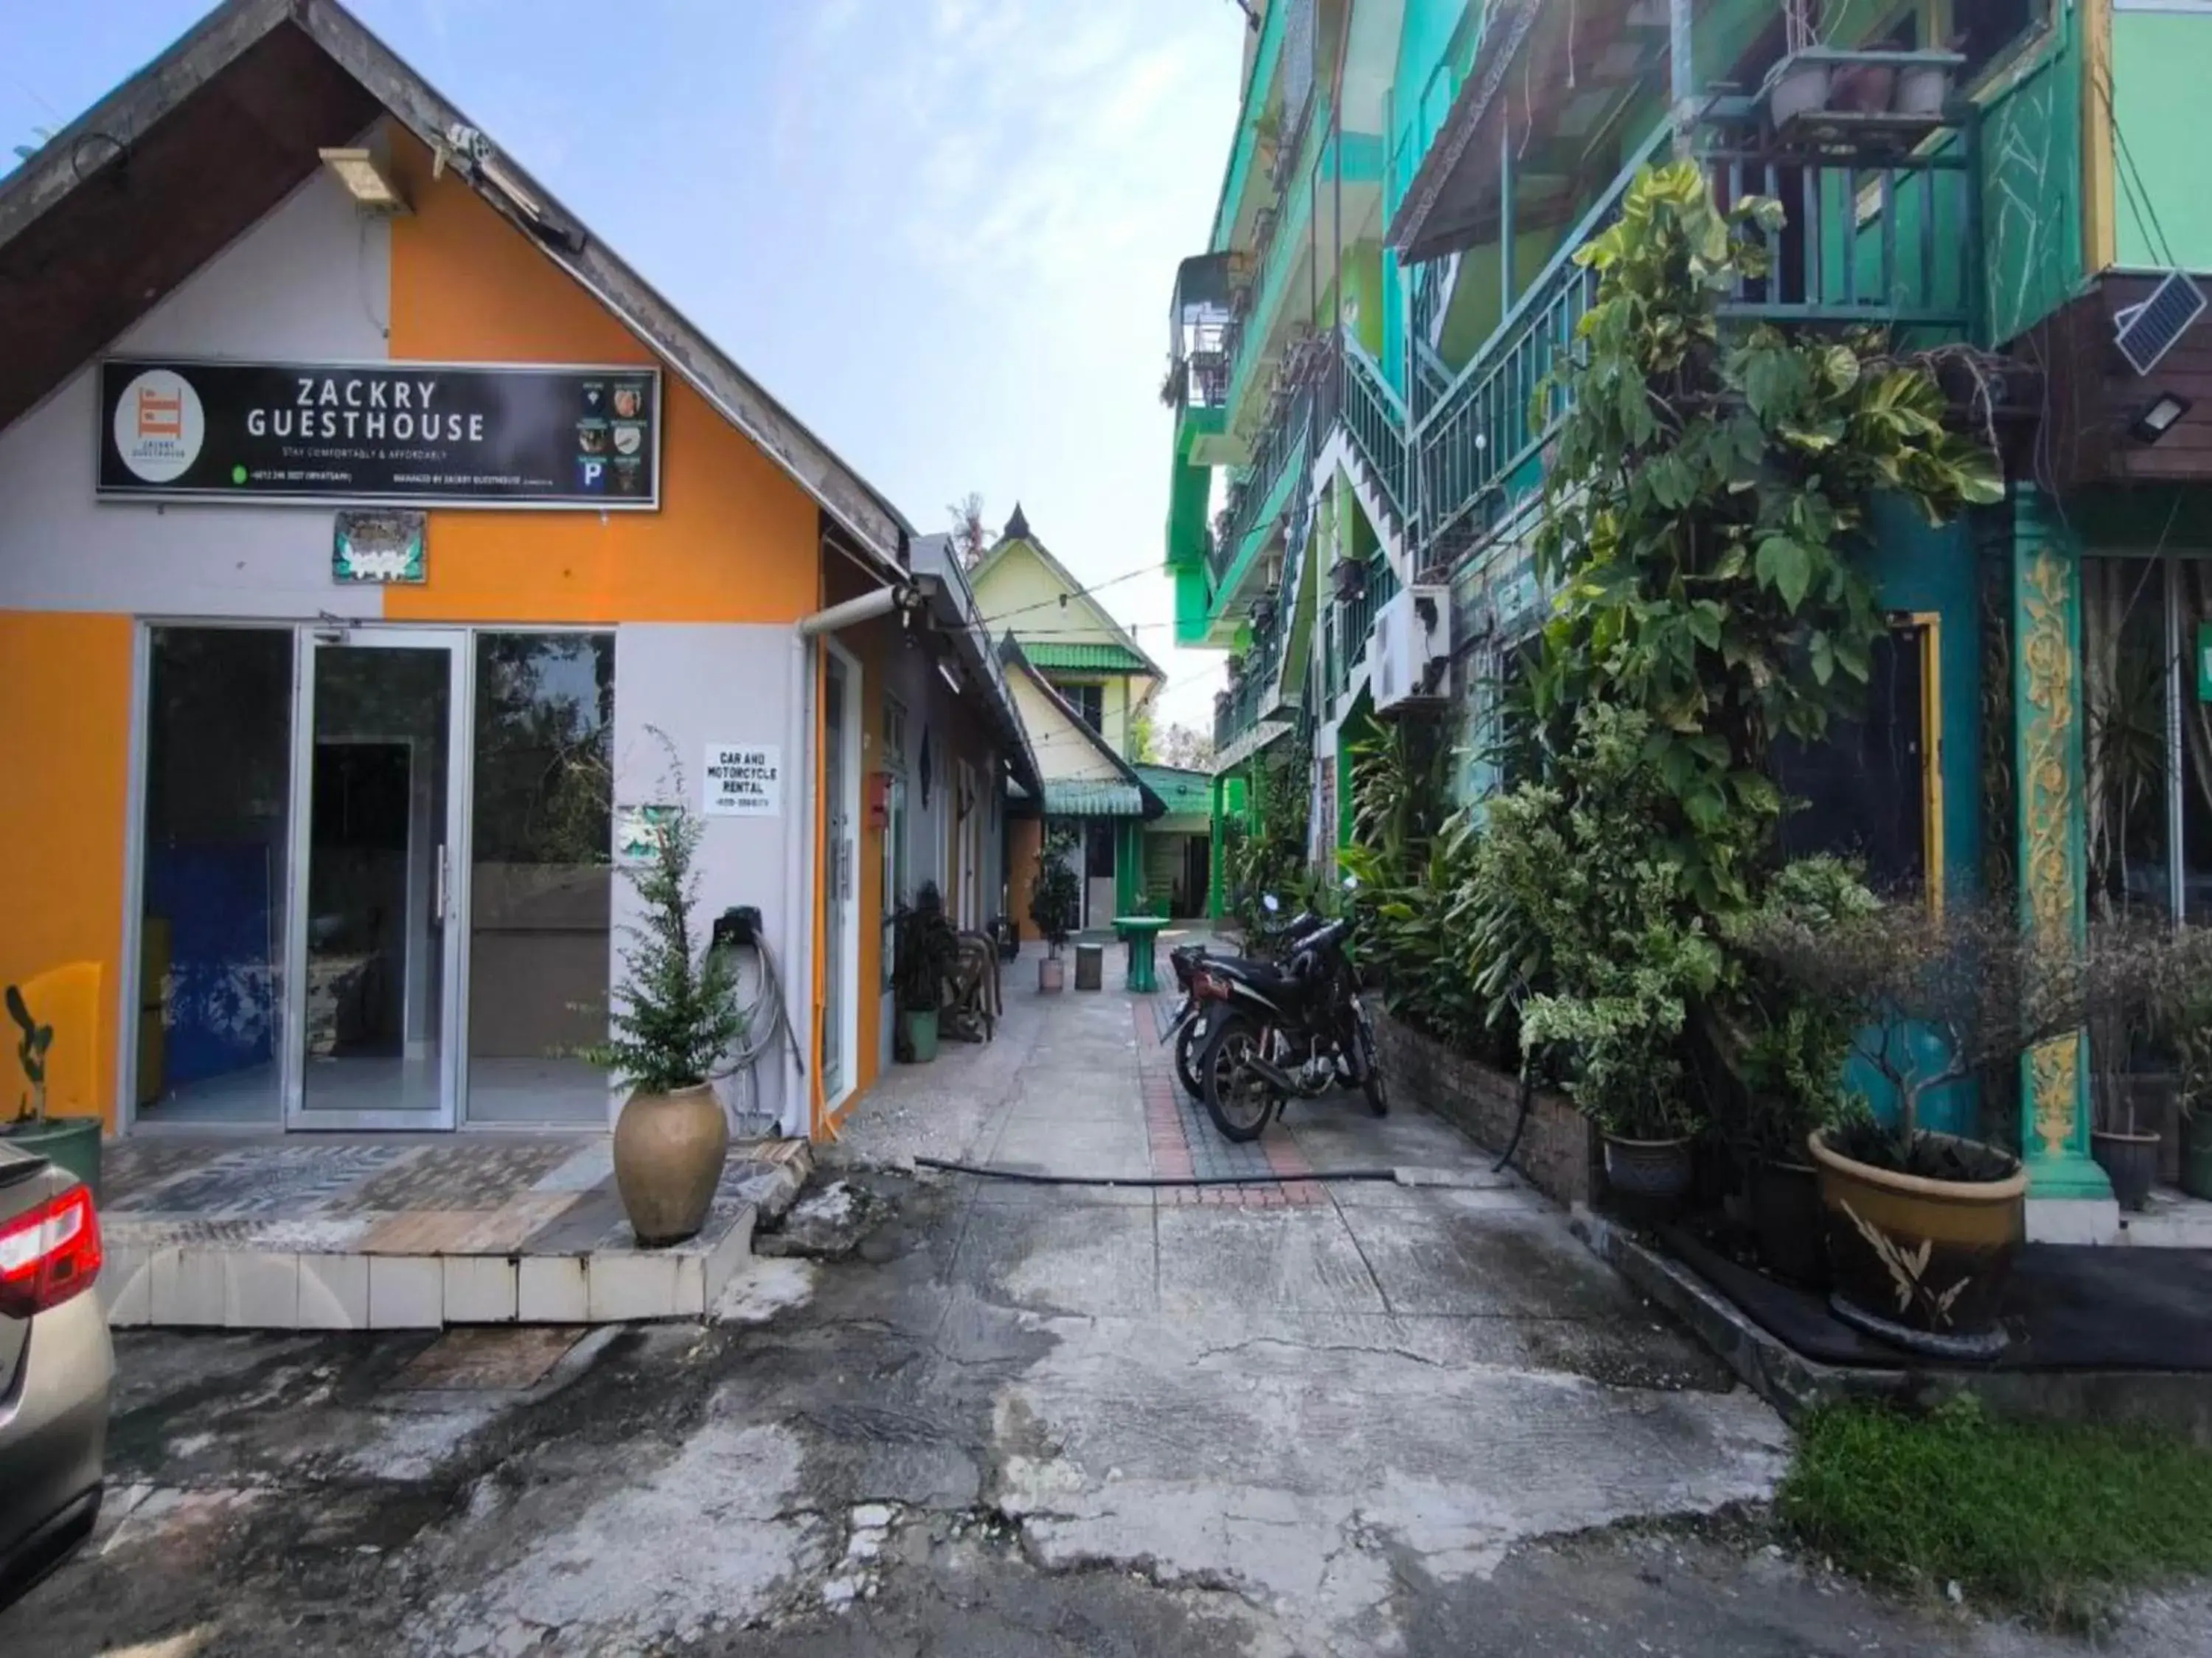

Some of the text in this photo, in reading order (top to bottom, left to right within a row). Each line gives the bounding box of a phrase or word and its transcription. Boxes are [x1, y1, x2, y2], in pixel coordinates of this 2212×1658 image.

[297, 378, 435, 409] ZACKRY
[248, 409, 483, 441] GUESTHOUSE
[282, 447, 304, 457] STAY
[307, 448, 376, 459] COMFORTABLY
[585, 462, 602, 487] P
[720, 752, 765, 766] CAR AND
[707, 766, 777, 781] MOTORCYCLE
[723, 780, 764, 794] RENTAL
